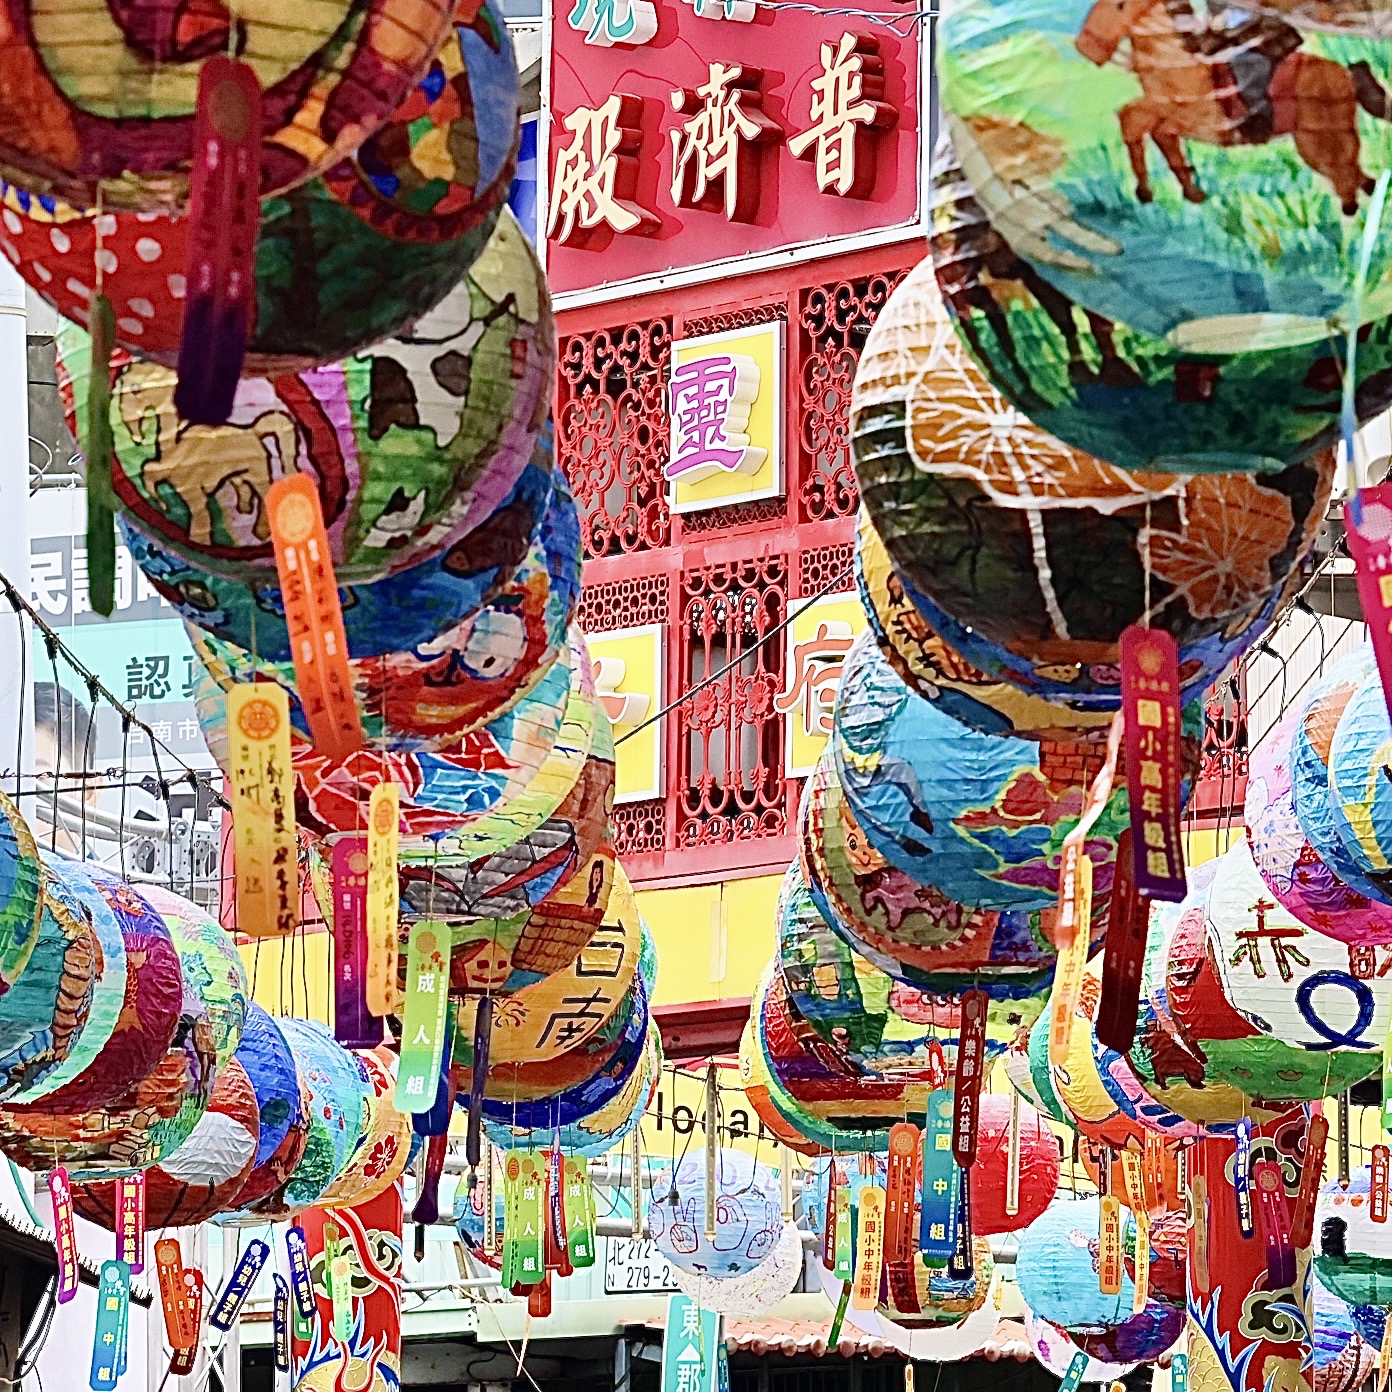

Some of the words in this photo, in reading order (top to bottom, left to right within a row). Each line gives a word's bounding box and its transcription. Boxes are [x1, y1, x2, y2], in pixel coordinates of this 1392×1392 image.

[546, 32, 875, 246] 普濟殿
[1135, 698, 1171, 880] 國小高年級組
[406, 973, 436, 1096] 成人組
[958, 1039, 977, 1153] 樂齡/公益組
[523, 1186, 537, 1272] 成人組
[569, 1185, 587, 1257] 成人組
[929, 1134, 951, 1241] 國中組
[607, 1273, 615, 1288] N
[609, 1239, 626, 1266] 北
[858, 1220, 876, 1300] 國小中年級組
[98, 1297, 120, 1381] 國中組
